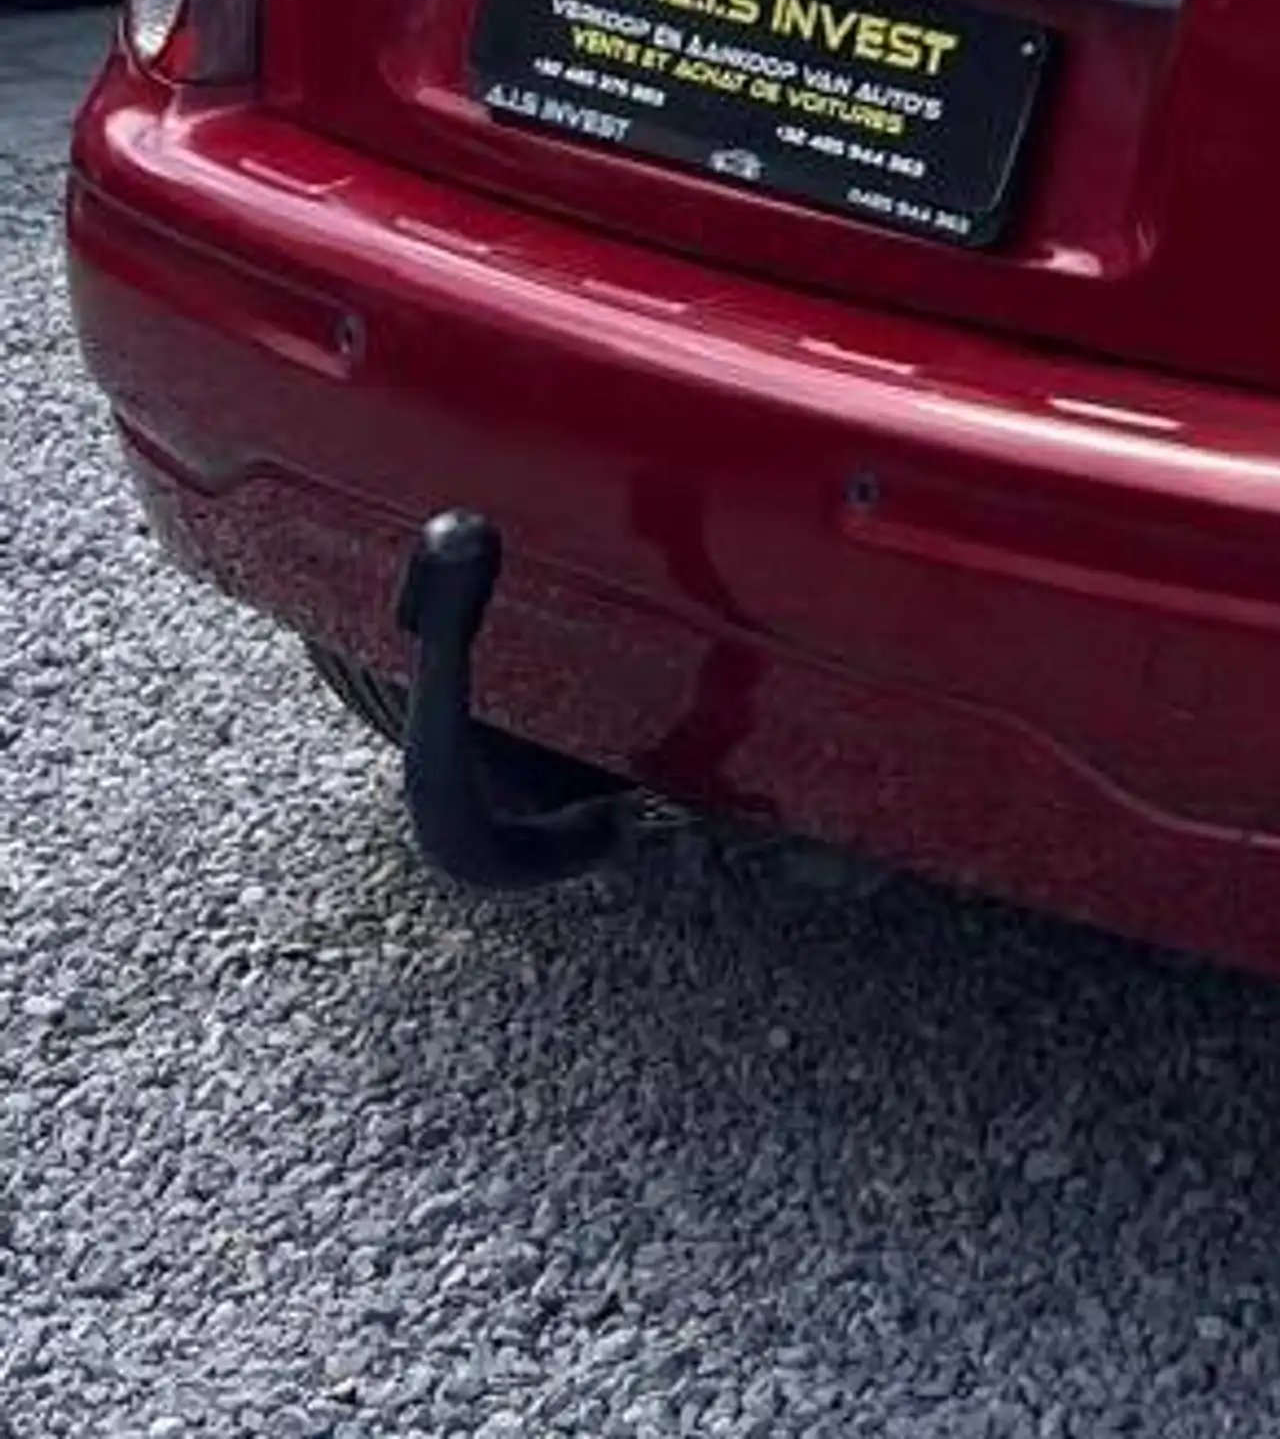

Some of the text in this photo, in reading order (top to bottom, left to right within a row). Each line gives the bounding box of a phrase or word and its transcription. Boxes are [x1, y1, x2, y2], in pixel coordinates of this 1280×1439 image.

[540, 95, 634, 142] INVEST
[571, 25, 905, 135] VENTE ET ACHAT DE VOITURES
[685, 34, 797, 79] AANKOOP
[803, 64, 852, 95] VAN
[855, 82, 943, 121] AUTO'S
